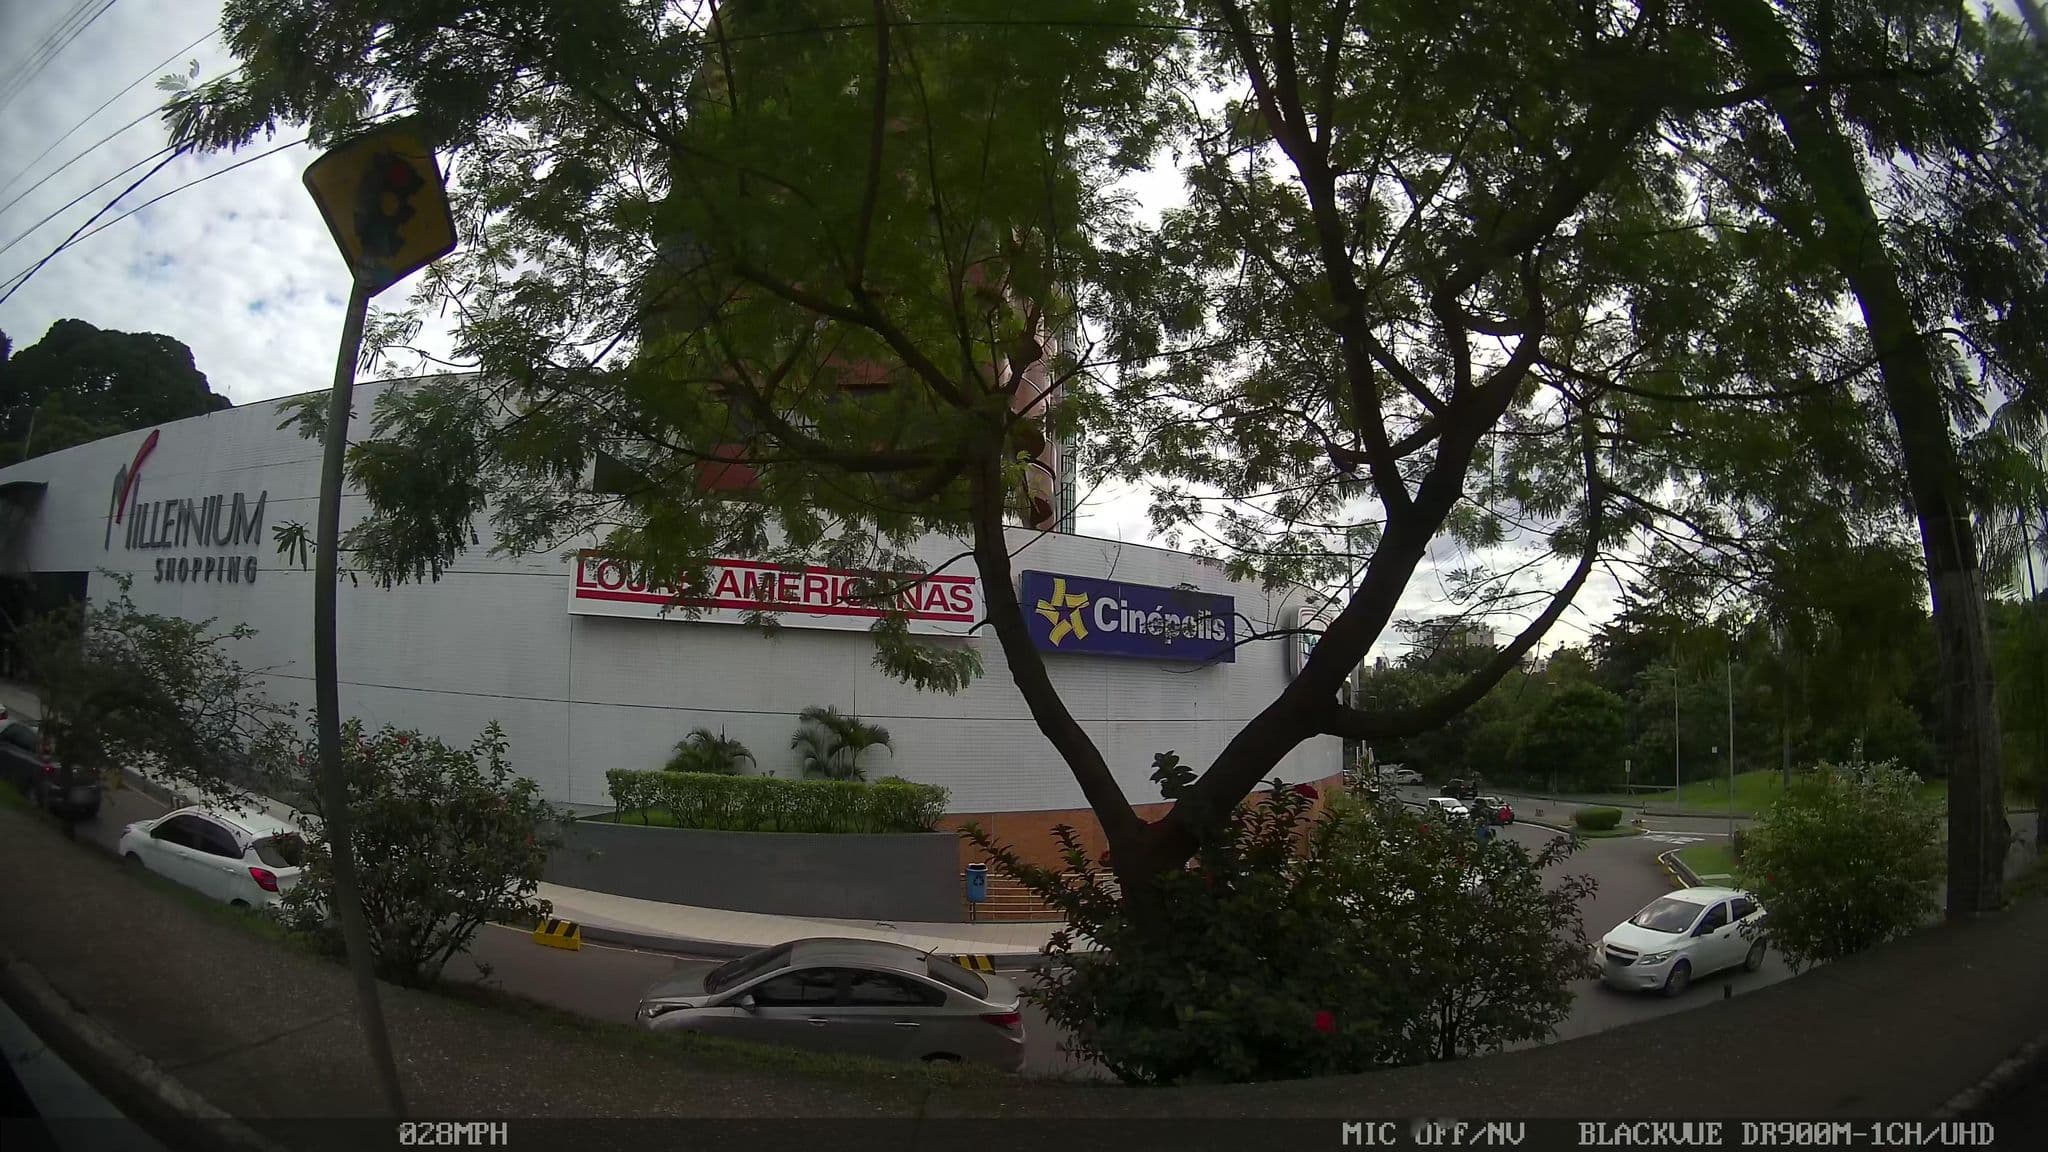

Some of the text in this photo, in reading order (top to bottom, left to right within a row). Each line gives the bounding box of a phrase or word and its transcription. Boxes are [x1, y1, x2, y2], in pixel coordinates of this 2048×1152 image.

[105, 429, 267, 551] MILLENNIUM
[154, 556, 258, 584] SHOPPING
[714, 569, 974, 614] AMERICNAS
[1094, 597, 1226, 645] Cinépolis
